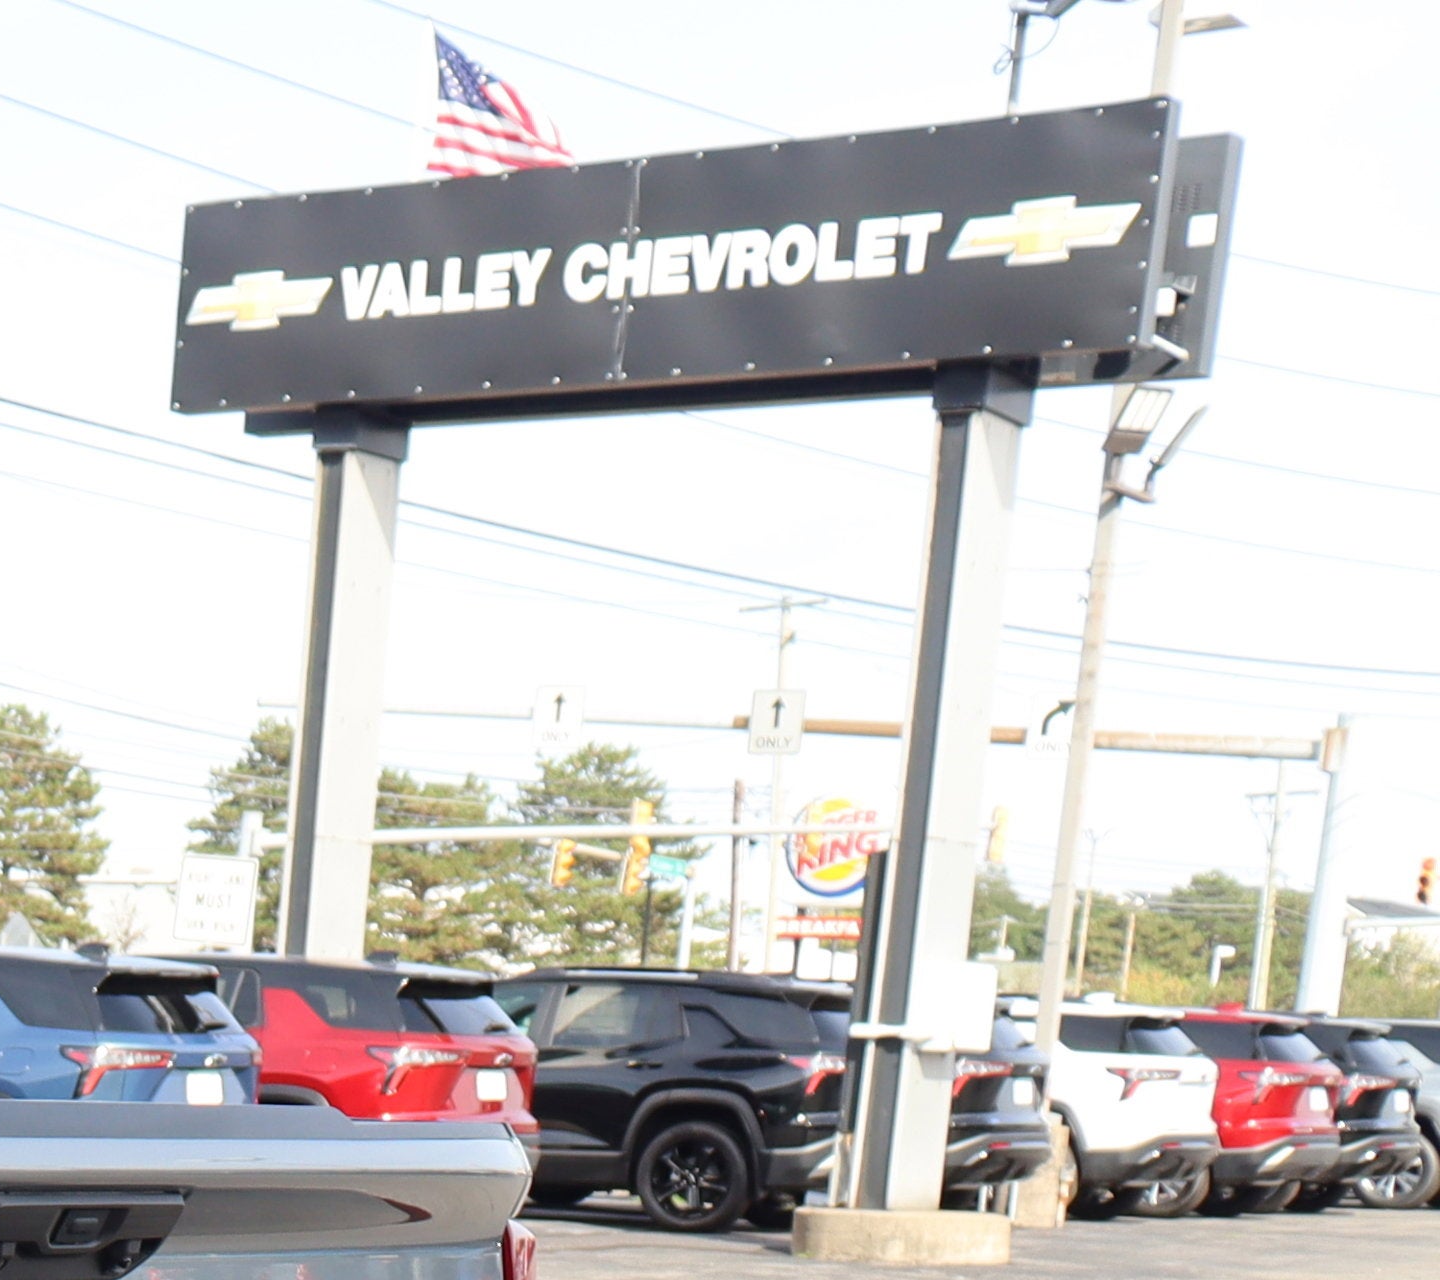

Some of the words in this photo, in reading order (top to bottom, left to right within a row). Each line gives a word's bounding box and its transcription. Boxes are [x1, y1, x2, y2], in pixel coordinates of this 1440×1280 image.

[341, 248, 551, 322] VALLEY
[563, 212, 943, 304] CHEVROLET
[755, 735, 793, 749] ONLY
[195, 893, 232, 909] MUST
